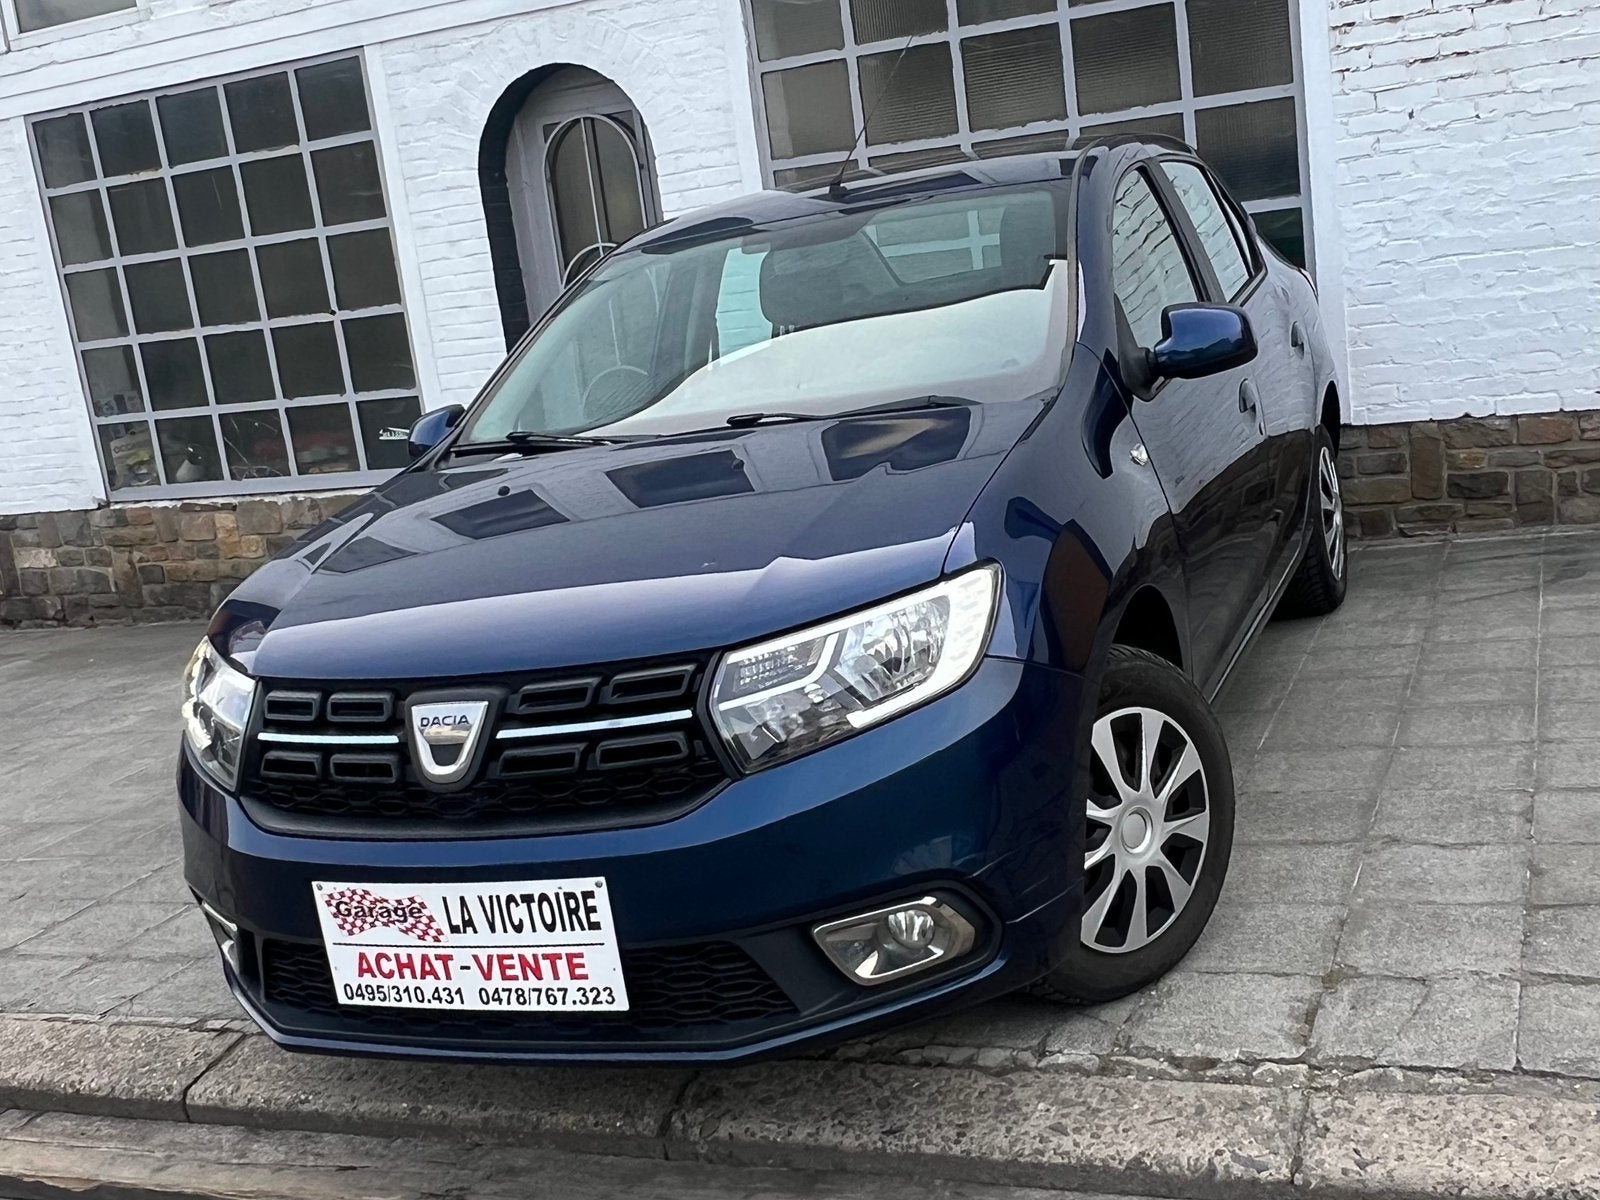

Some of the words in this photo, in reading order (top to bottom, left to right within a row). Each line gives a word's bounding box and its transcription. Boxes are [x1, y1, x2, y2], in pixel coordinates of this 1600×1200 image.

[420, 714, 470, 728] DACIA
[335, 900, 424, 924] Garage
[441, 895, 479, 935] LA
[476, 889, 602, 935] VICTOIRE
[343, 983, 465, 1006] 0495/310.431
[478, 986, 616, 1006] 0478/767.323
